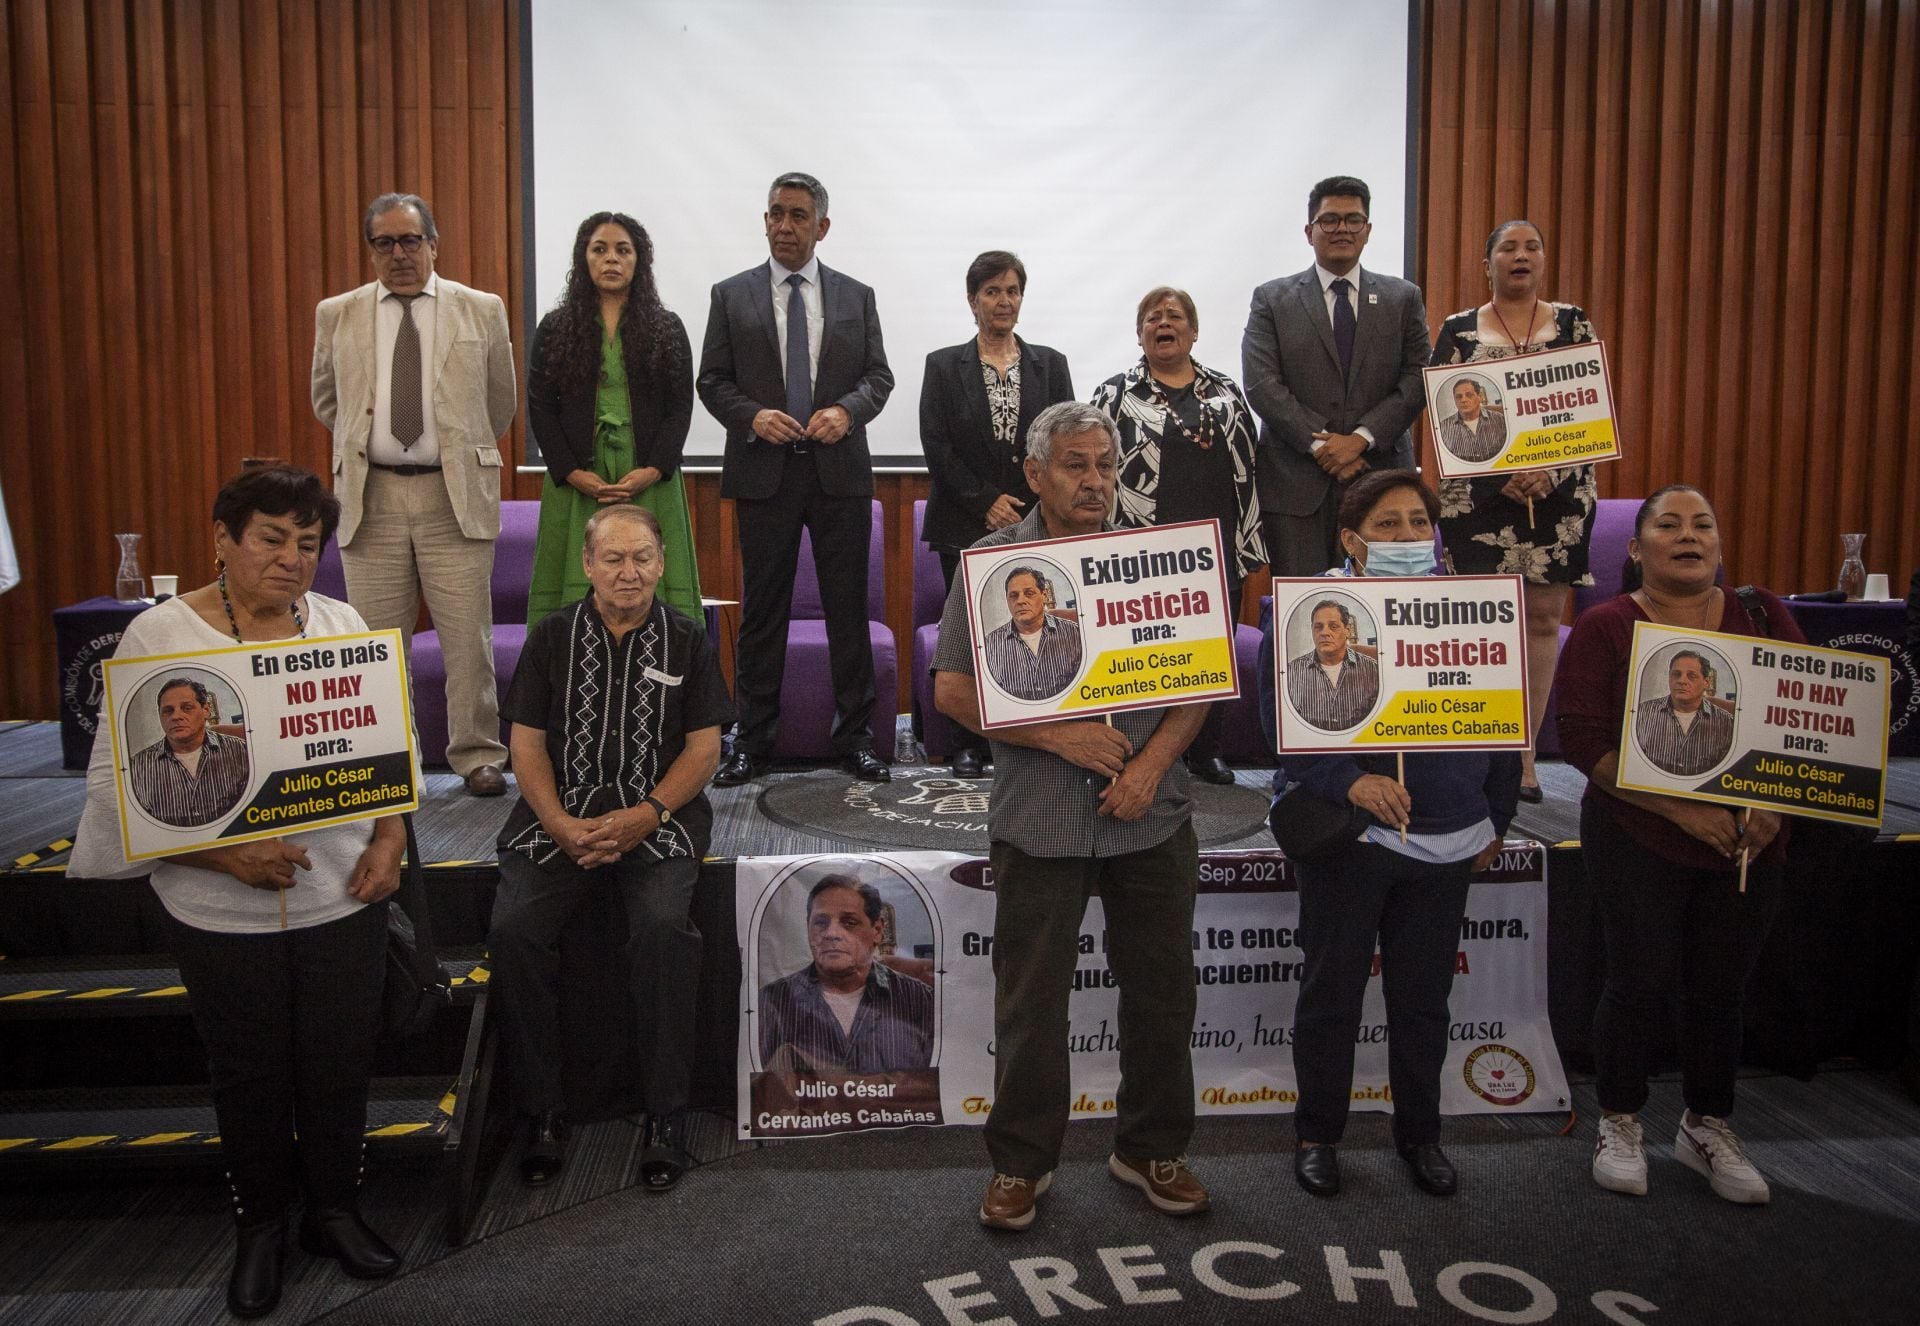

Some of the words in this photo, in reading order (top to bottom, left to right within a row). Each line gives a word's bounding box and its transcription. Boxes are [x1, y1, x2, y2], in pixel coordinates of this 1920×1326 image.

[1504, 359, 1600, 390] Exigimos
[1516, 387, 1598, 417] Justicia
[1542, 412, 1574, 427] para:
[1526, 434, 1552, 447] Julio
[1554, 429, 1586, 442] César
[1506, 450, 1560, 464] Cervantes
[1564, 440, 1612, 456] Cabañas
[1080, 546, 1214, 586] Exigimos
[1096, 588, 1210, 627] Justicia
[1384, 598, 1514, 629] Exigimos
[90, 631, 122, 650] DERE
[1132, 624, 1176, 644] para:
[1829, 633, 1902, 654] DERECHOS
[251, 654, 280, 677] En
[286, 648, 336, 673] este
[341, 641, 389, 667] país
[1108, 657, 1144, 674] Julio
[1148, 651, 1193, 668] César
[1395, 638, 1506, 667] Justicia
[1752, 646, 1776, 668] En
[1780, 652, 1826, 676] este
[1830, 658, 1876, 683] país
[286, 680, 316, 706] NO
[322, 674, 362, 700] HAY
[1080, 680, 1156, 700] Cervantes
[1162, 670, 1228, 690] Cabañas
[1428, 670, 1472, 687] para:
[1776, 678, 1804, 702] NO
[1809, 684, 1848, 706] HAY
[1402, 700, 1437, 714] Julio
[1442, 698, 1486, 712] César
[279, 704, 378, 740] JUSTICIA
[1374, 722, 1448, 736] Cervantes
[1452, 720, 1520, 735] Cabañas
[1764, 705, 1856, 737] JUSTICIA
[304, 738, 353, 760] para:
[1784, 734, 1828, 754] para:
[280, 773, 321, 794] Julio
[325, 765, 374, 785] César
[1756, 758, 1794, 777] Julio
[1798, 762, 1844, 784] César
[246, 796, 334, 824] Cervantes
[338, 782, 409, 808] Cabañas
[1720, 774, 1802, 799] Cervantes
[1806, 786, 1876, 810] Cabañas
[1200, 864, 1236, 886] Sep
[1242, 861, 1286, 882] 2021
[1482, 852, 1534, 872] DMX
[1460, 917, 1529, 940] hora,
[1195, 961, 1304, 985] cuentro
[1450, 1022, 1506, 1041] casa
[795, 1080, 838, 1098] Julio
[844, 1080, 896, 1098] César
[758, 1111, 852, 1129] Cervantes
[857, 1109, 936, 1124] Cabañas
[812, 1240, 1660, 1326] ERECHO
